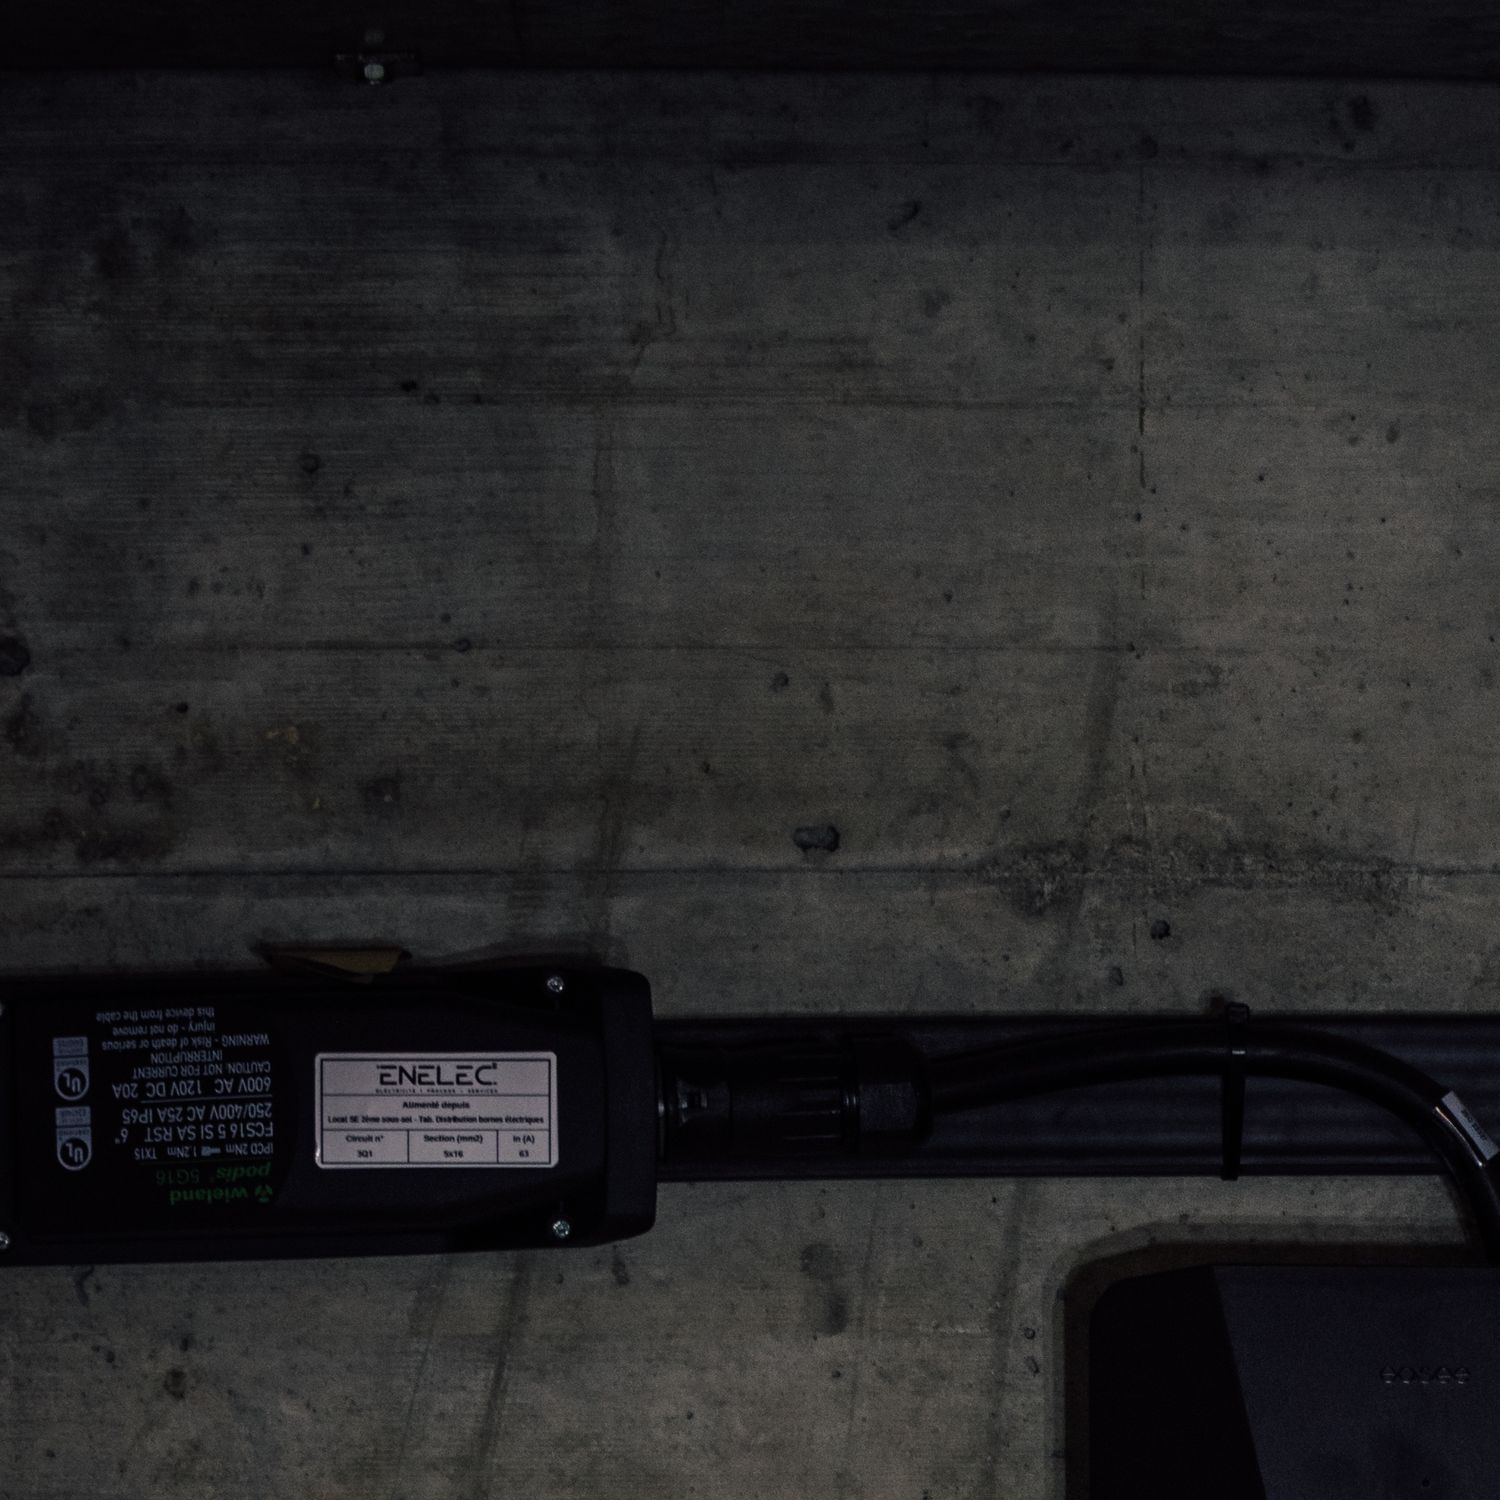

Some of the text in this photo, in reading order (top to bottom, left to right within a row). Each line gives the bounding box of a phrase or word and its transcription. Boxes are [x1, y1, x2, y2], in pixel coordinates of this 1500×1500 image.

[96, 1006, 214, 1024] this device from the cable
[112, 1025, 148, 1037] remove
[150, 1024, 164, 1036] not
[167, 1023, 178, 1035] do
[188, 1020, 215, 1034] injury
[102, 1040, 136, 1052] serious
[140, 1039, 149, 1049] or
[152, 1038, 177, 1050] death
[180, 1037, 189, 1049] of
[192, 1036, 212, 1048] Risk
[221, 1032, 270, 1047] WARNING
[150, 1049, 223, 1063] INTERRUPTION
[131, 1065, 178, 1079] CURRENT
[181, 1064, 200, 1077] FOR
[204, 1063, 223, 1076] NOT
[62, 1072, 81, 1090] UL
[112, 1076, 271, 1098] 600V AC 120V DC 20A
[403, 1101, 470, 1110] Alimenté depuis
[122, 1102, 273, 1124] 250/400V AC 25A IP65
[505, 1116, 544, 1124] électriques
[144, 1126, 172, 1142] RST
[174, 1124, 196, 1140] SA
[200, 1123, 214, 1139] SI
[217, 1123, 226, 1138] 5
[230, 1120, 273, 1138] FCS16
[346, 1135, 373, 1143] Circuit
[424, 1135, 455, 1143] Section
[457, 1134, 483, 1144] (mm2)
[523, 1135, 535, 1144] (A)
[65, 1142, 84, 1160] UL
[133, 1147, 157, 1160] TX15
[167, 1145, 198, 1158] 1.2Nm
[225, 1143, 248, 1156] 2Nm
[155, 1168, 200, 1184] 5G16
[168, 1186, 248, 1204] wieland
